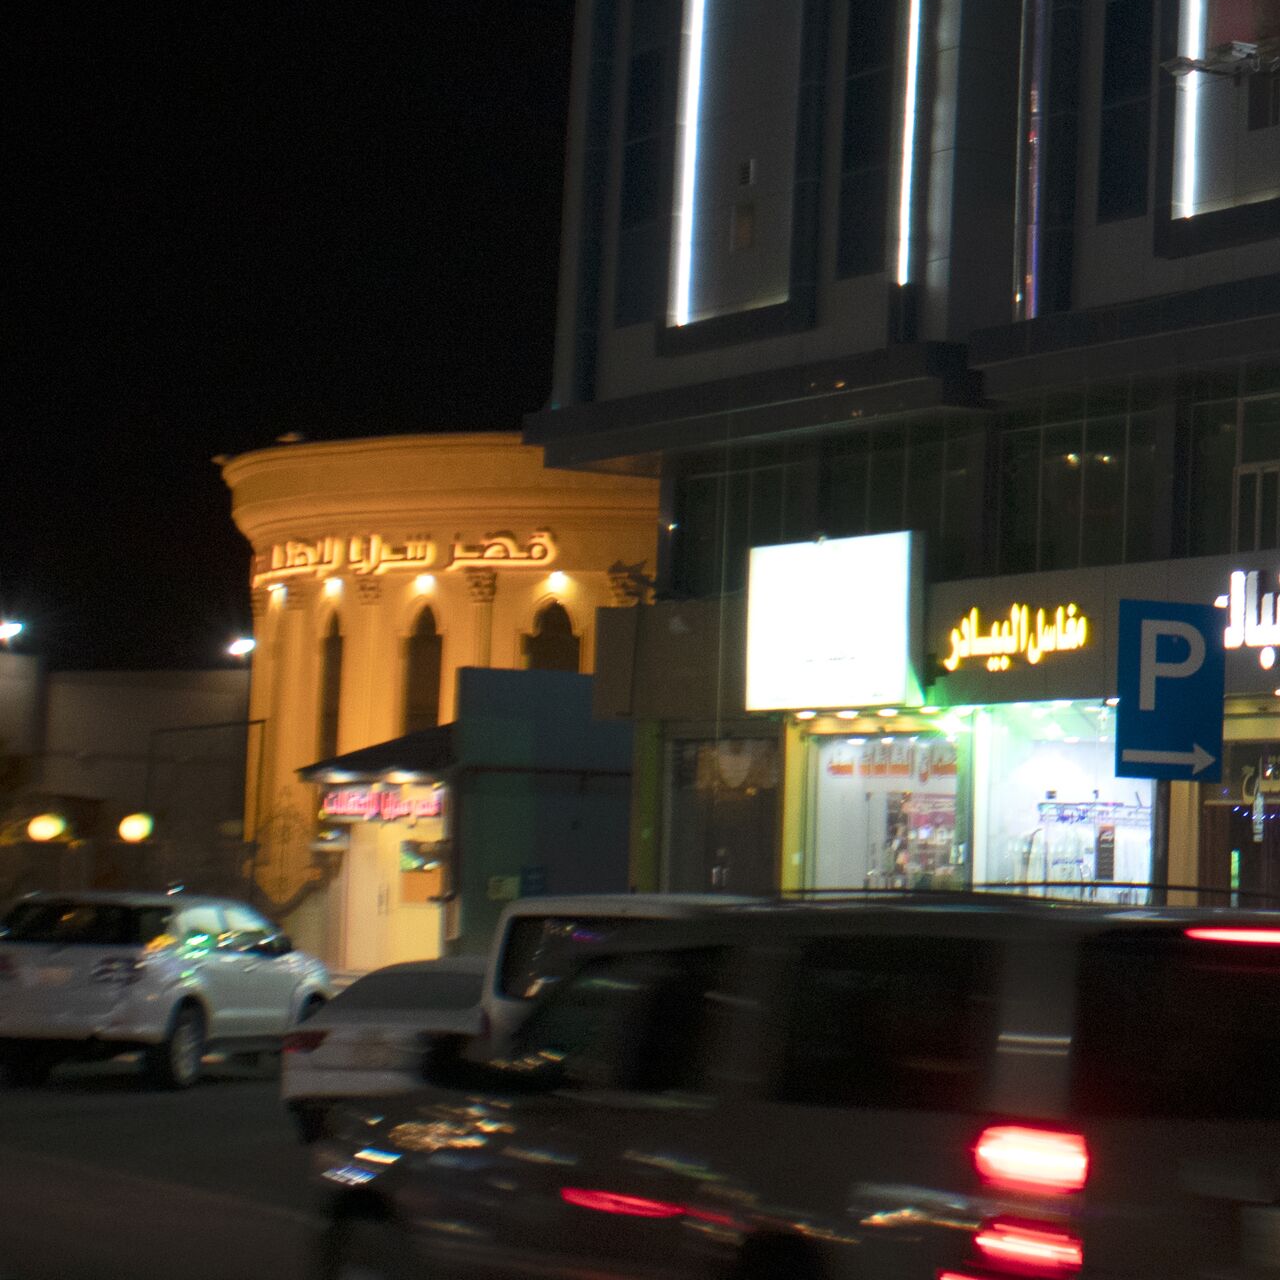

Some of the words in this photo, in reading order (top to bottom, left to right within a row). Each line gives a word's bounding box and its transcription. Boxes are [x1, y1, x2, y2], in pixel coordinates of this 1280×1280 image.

[943, 602, 1029, 672] البيادر
[1027, 602, 1088, 665] مغاسل
[1139, 619, 1206, 711] P
